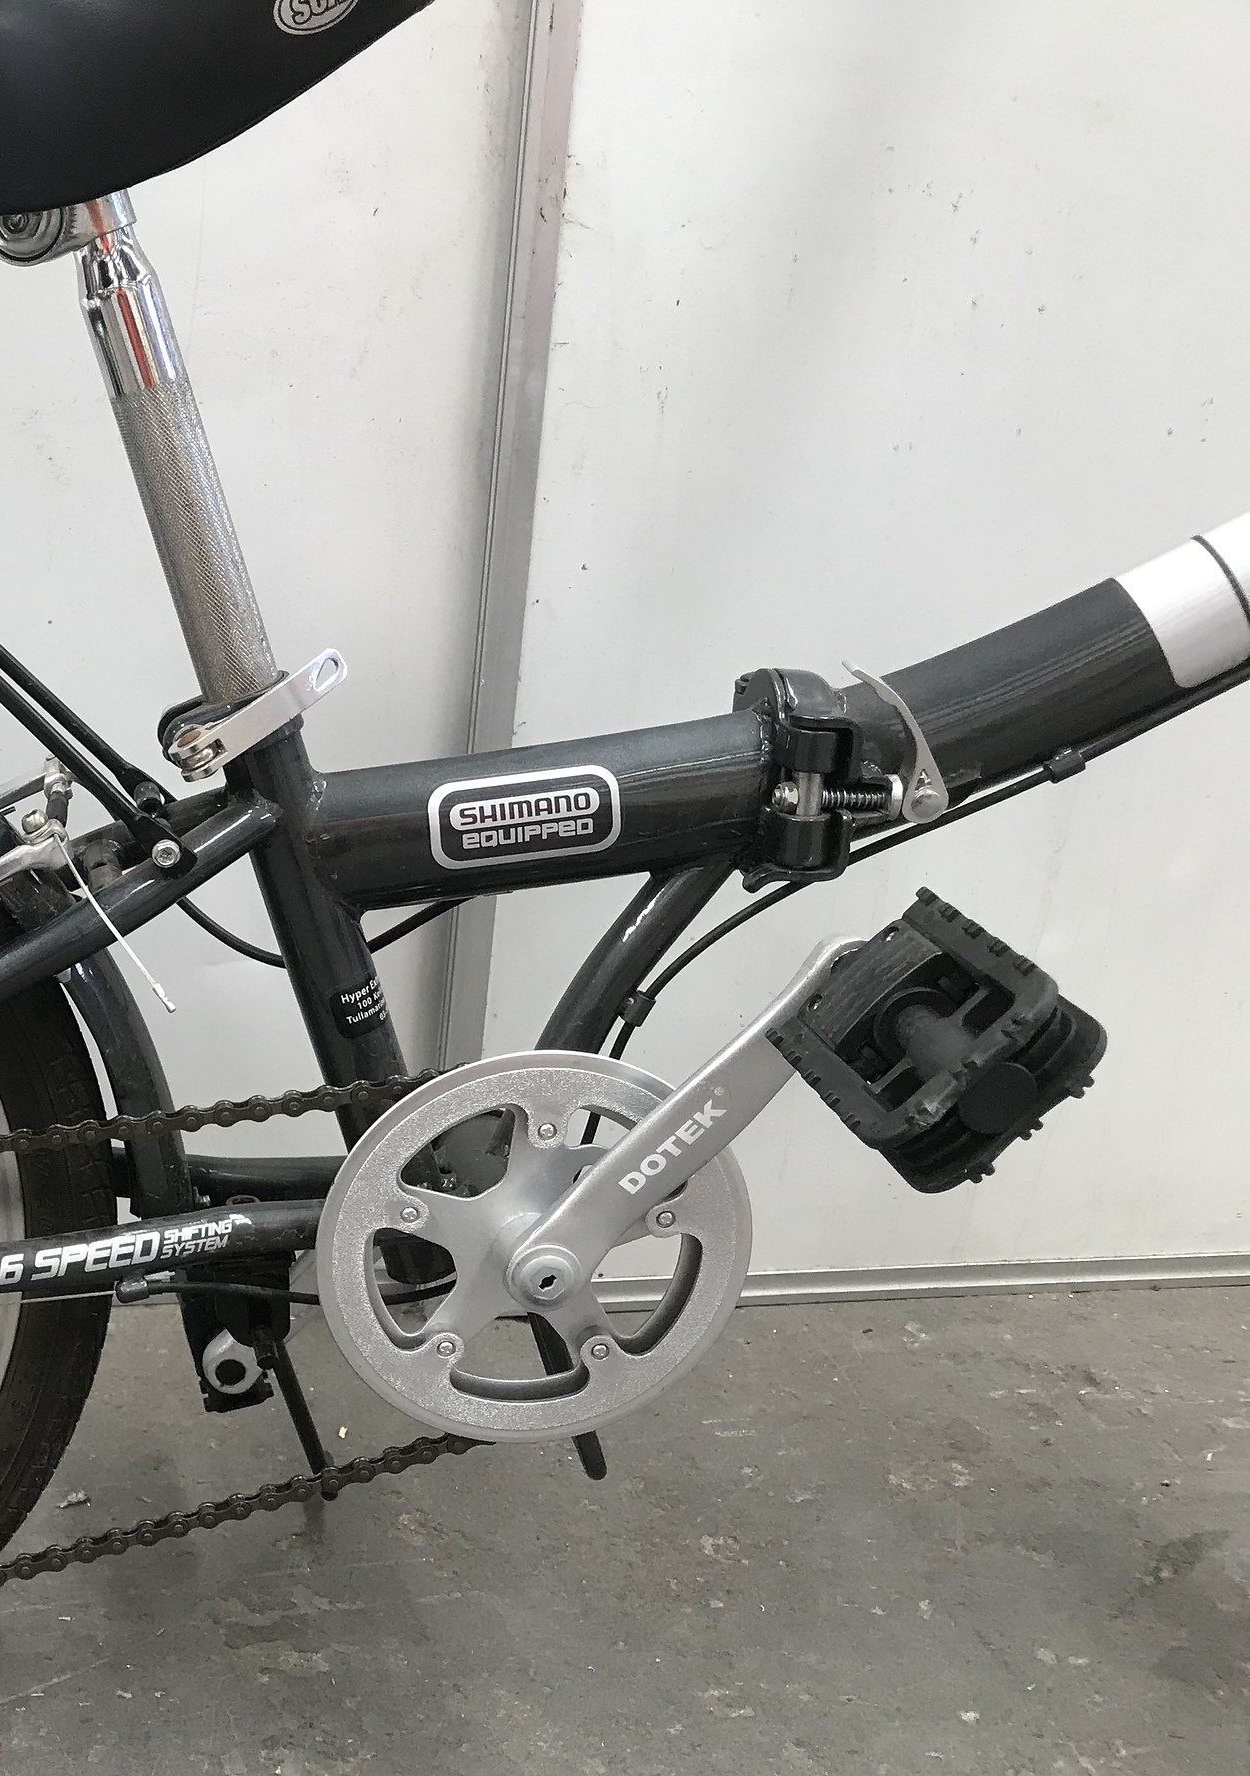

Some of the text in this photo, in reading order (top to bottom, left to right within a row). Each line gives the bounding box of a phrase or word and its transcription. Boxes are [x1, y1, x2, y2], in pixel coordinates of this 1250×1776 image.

[459, 792, 591, 826] SHIMANO
[340, 985, 369, 1004] Hyper
[357, 996, 372, 1010] 100
[618, 1099, 727, 1195] DOTEK
[163, 1219, 232, 1245] SHIFTING
[31, 1230, 160, 1281] SPEED
[160, 1236, 229, 1259] SYSTEM
